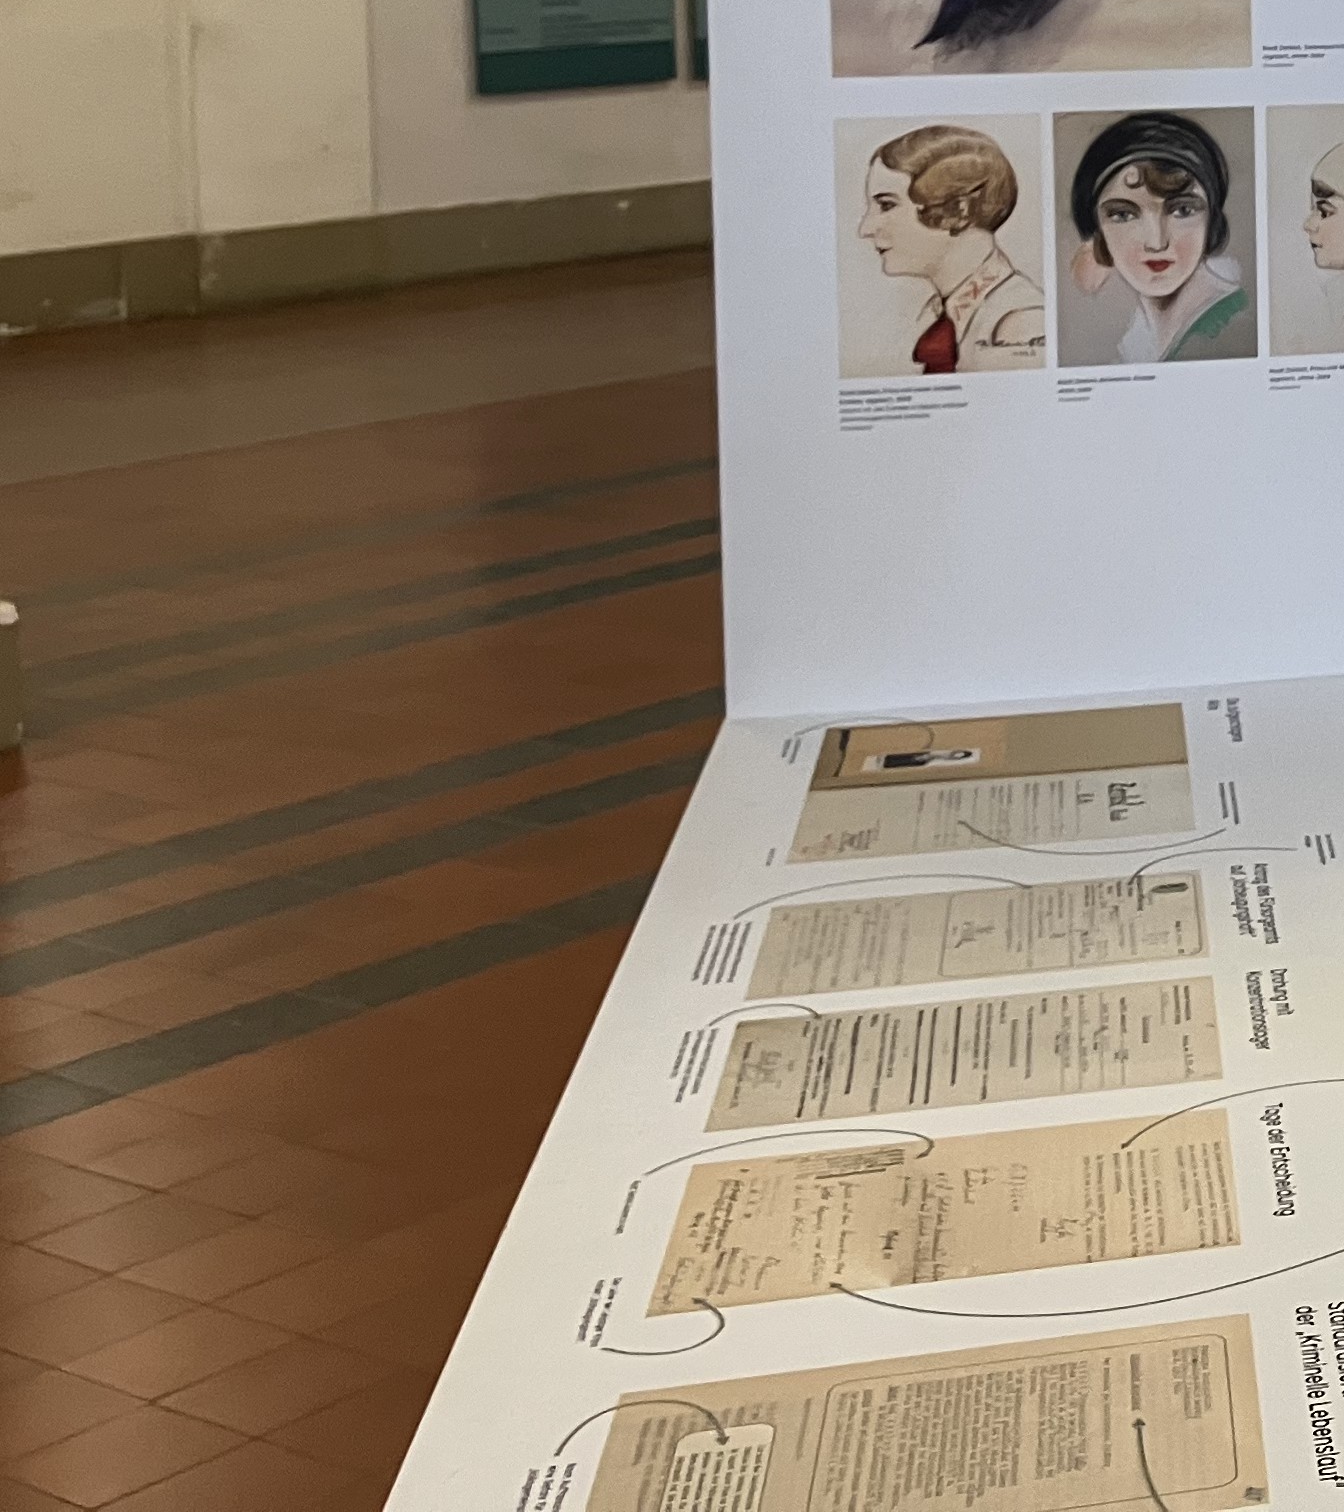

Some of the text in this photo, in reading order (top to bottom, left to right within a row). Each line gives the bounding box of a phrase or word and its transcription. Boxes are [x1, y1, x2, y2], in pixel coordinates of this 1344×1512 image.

[1259, 1102, 1297, 1217] Tage der Entscheidung
[1295, 1305, 1319, 1326] der
